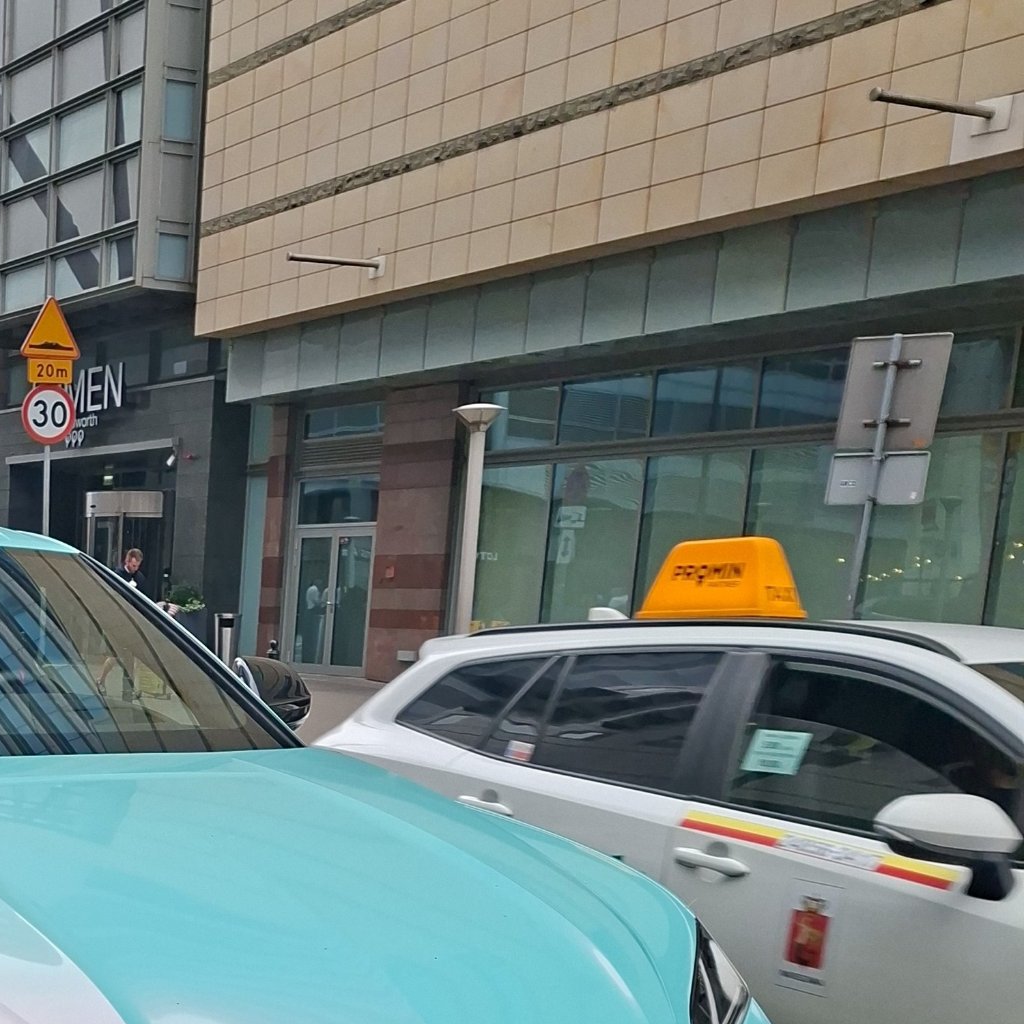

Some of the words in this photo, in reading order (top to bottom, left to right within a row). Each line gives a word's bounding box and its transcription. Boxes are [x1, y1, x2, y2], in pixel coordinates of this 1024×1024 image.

[65, 361, 123, 413] MEN
[32, 399, 68, 428] 30
[75, 413, 98, 428] worth
